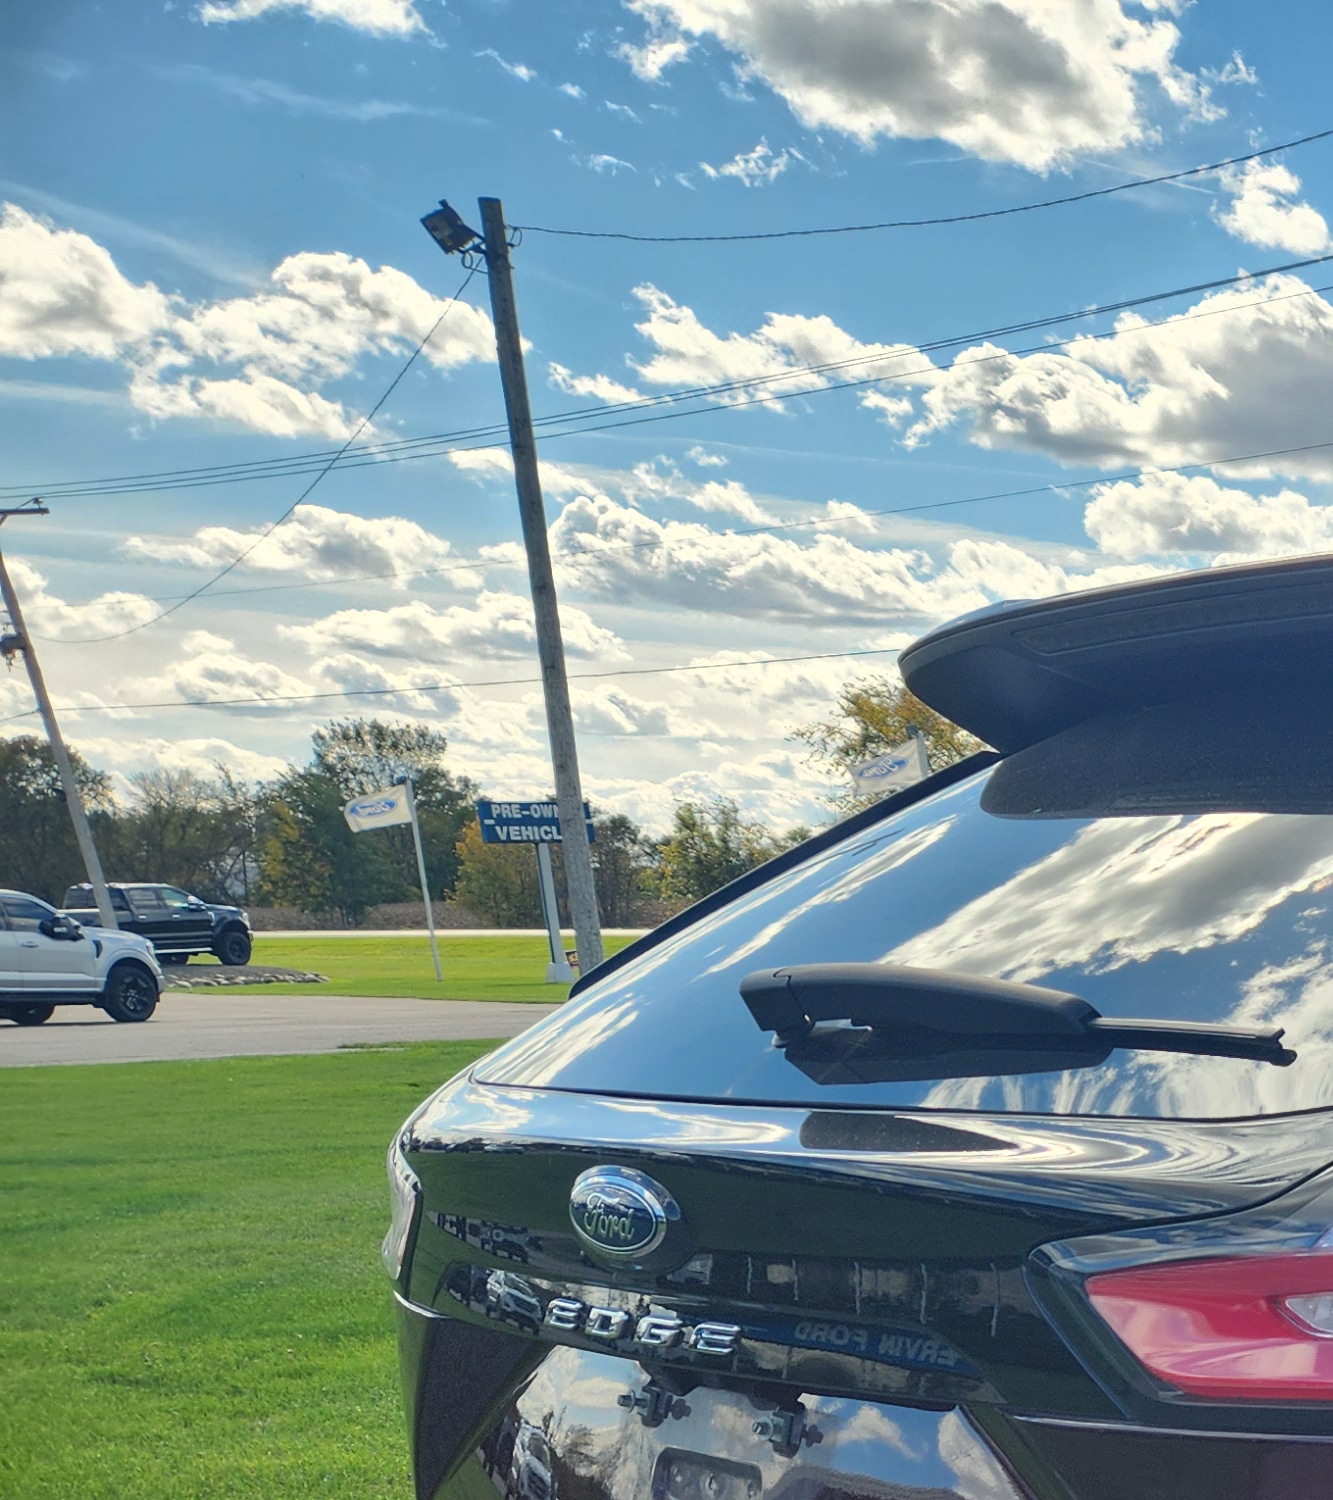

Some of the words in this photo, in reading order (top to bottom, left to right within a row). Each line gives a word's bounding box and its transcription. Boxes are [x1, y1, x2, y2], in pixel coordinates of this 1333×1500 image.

[491, 804, 559, 818] PRE-OW
[495, 825, 563, 841] VEHICL
[584, 1192, 635, 1240] Ford
[543, 1298, 741, 1356] EDGE
